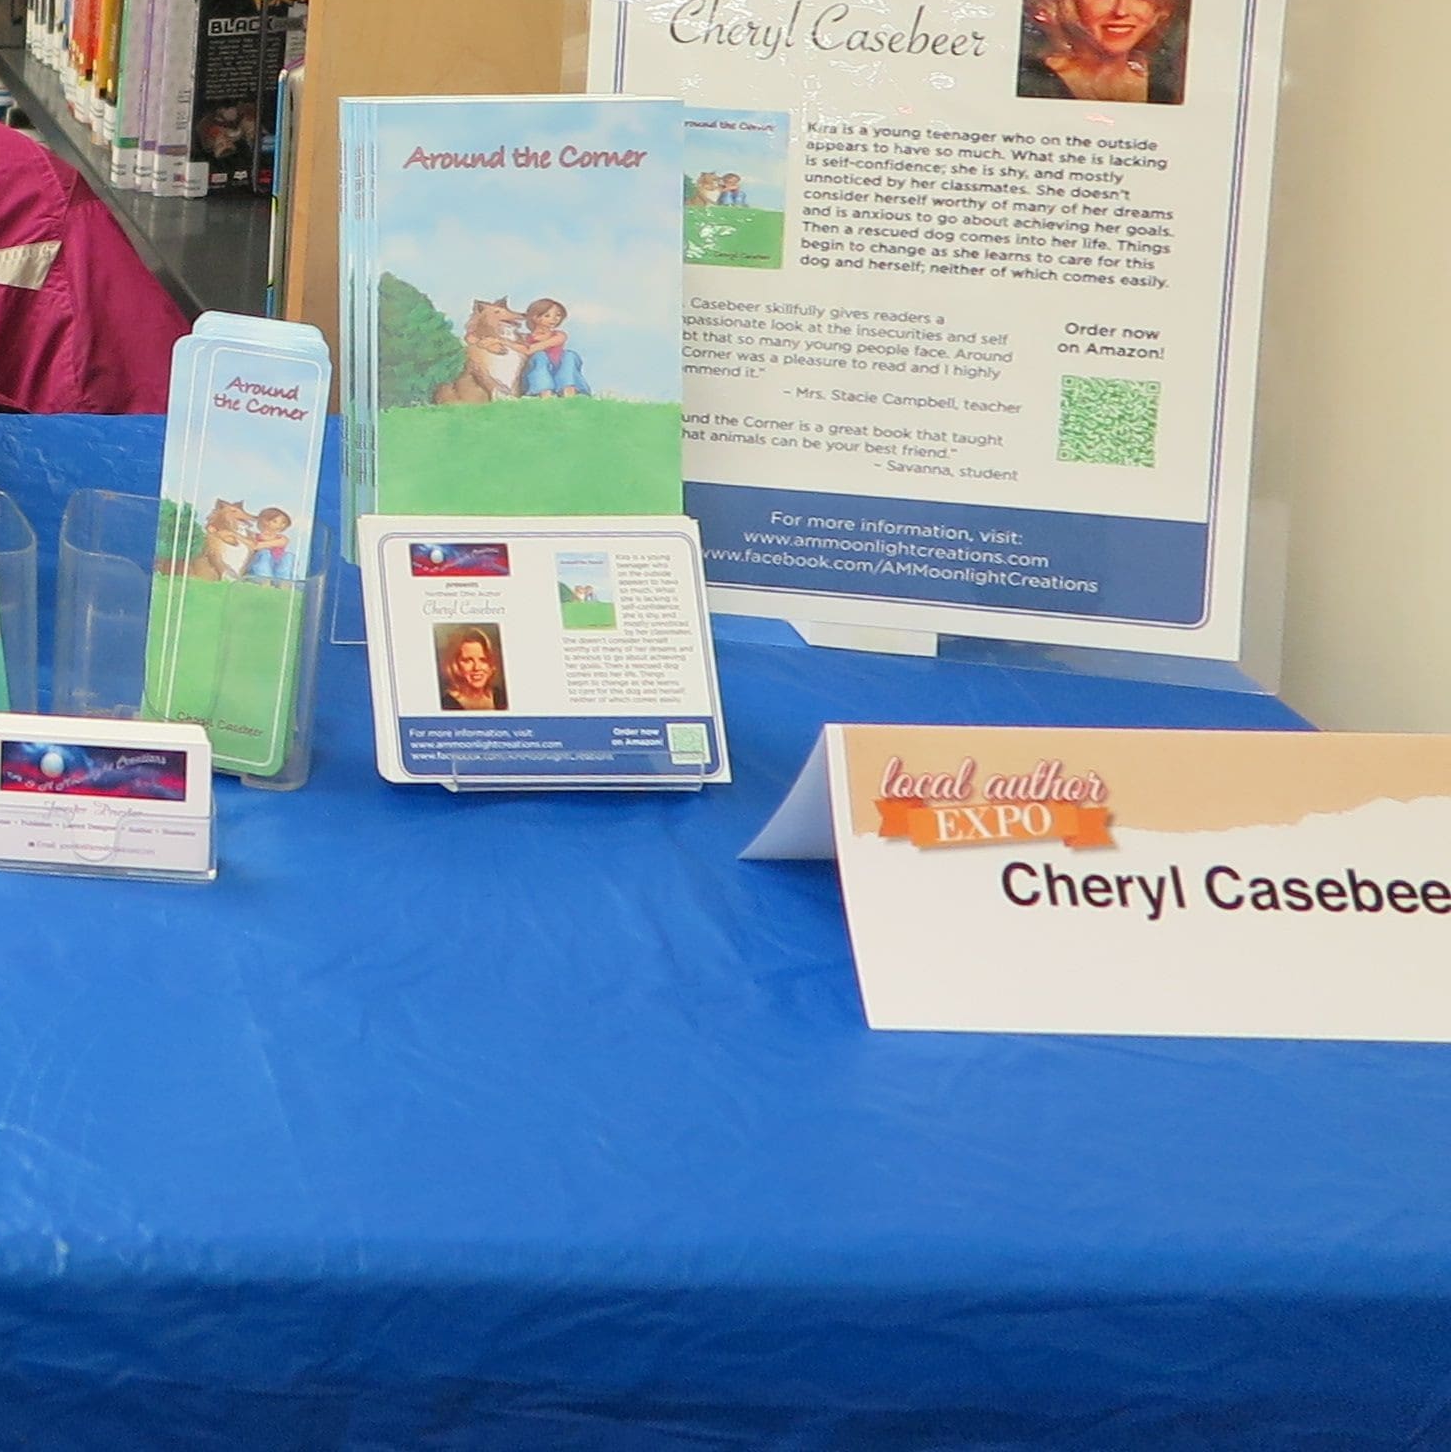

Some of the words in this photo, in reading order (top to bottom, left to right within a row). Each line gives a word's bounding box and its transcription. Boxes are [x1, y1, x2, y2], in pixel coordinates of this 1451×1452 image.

[811, 2, 988, 58] Casebeer
[403, 145, 505, 172] Around
[513, 146, 552, 169] the
[558, 145, 648, 172] Corner
[800, 254, 830, 270] dog
[835, 256, 863, 269] and
[867, 258, 927, 275] herself;
[930, 262, 986, 277] neither
[991, 266, 1007, 278] of
[1010, 267, 1058, 282] which
[1063, 270, 1115, 286] comes
[1120, 275, 1171, 290] easily.
[1064, 321, 1117, 340] Order
[1123, 327, 1161, 341] now
[1058, 342, 1081, 355] on
[1085, 342, 1165, 360] Amazon!
[226, 375, 301, 402] Around
[213, 393, 241, 413] the
[245, 397, 310, 422] Corner
[769, 510, 802, 526] For
[807, 516, 855, 532] more
[860, 518, 974, 543] information,
[978, 529, 1023, 546] visit:
[743, 530, 1050, 568] www.ammoonlightcreations.com
[880, 754, 973, 801] local
[983, 758, 1109, 803] author
[934, 800, 1054, 843] EXPO
[999, 860, 1187, 922] Cheryl
